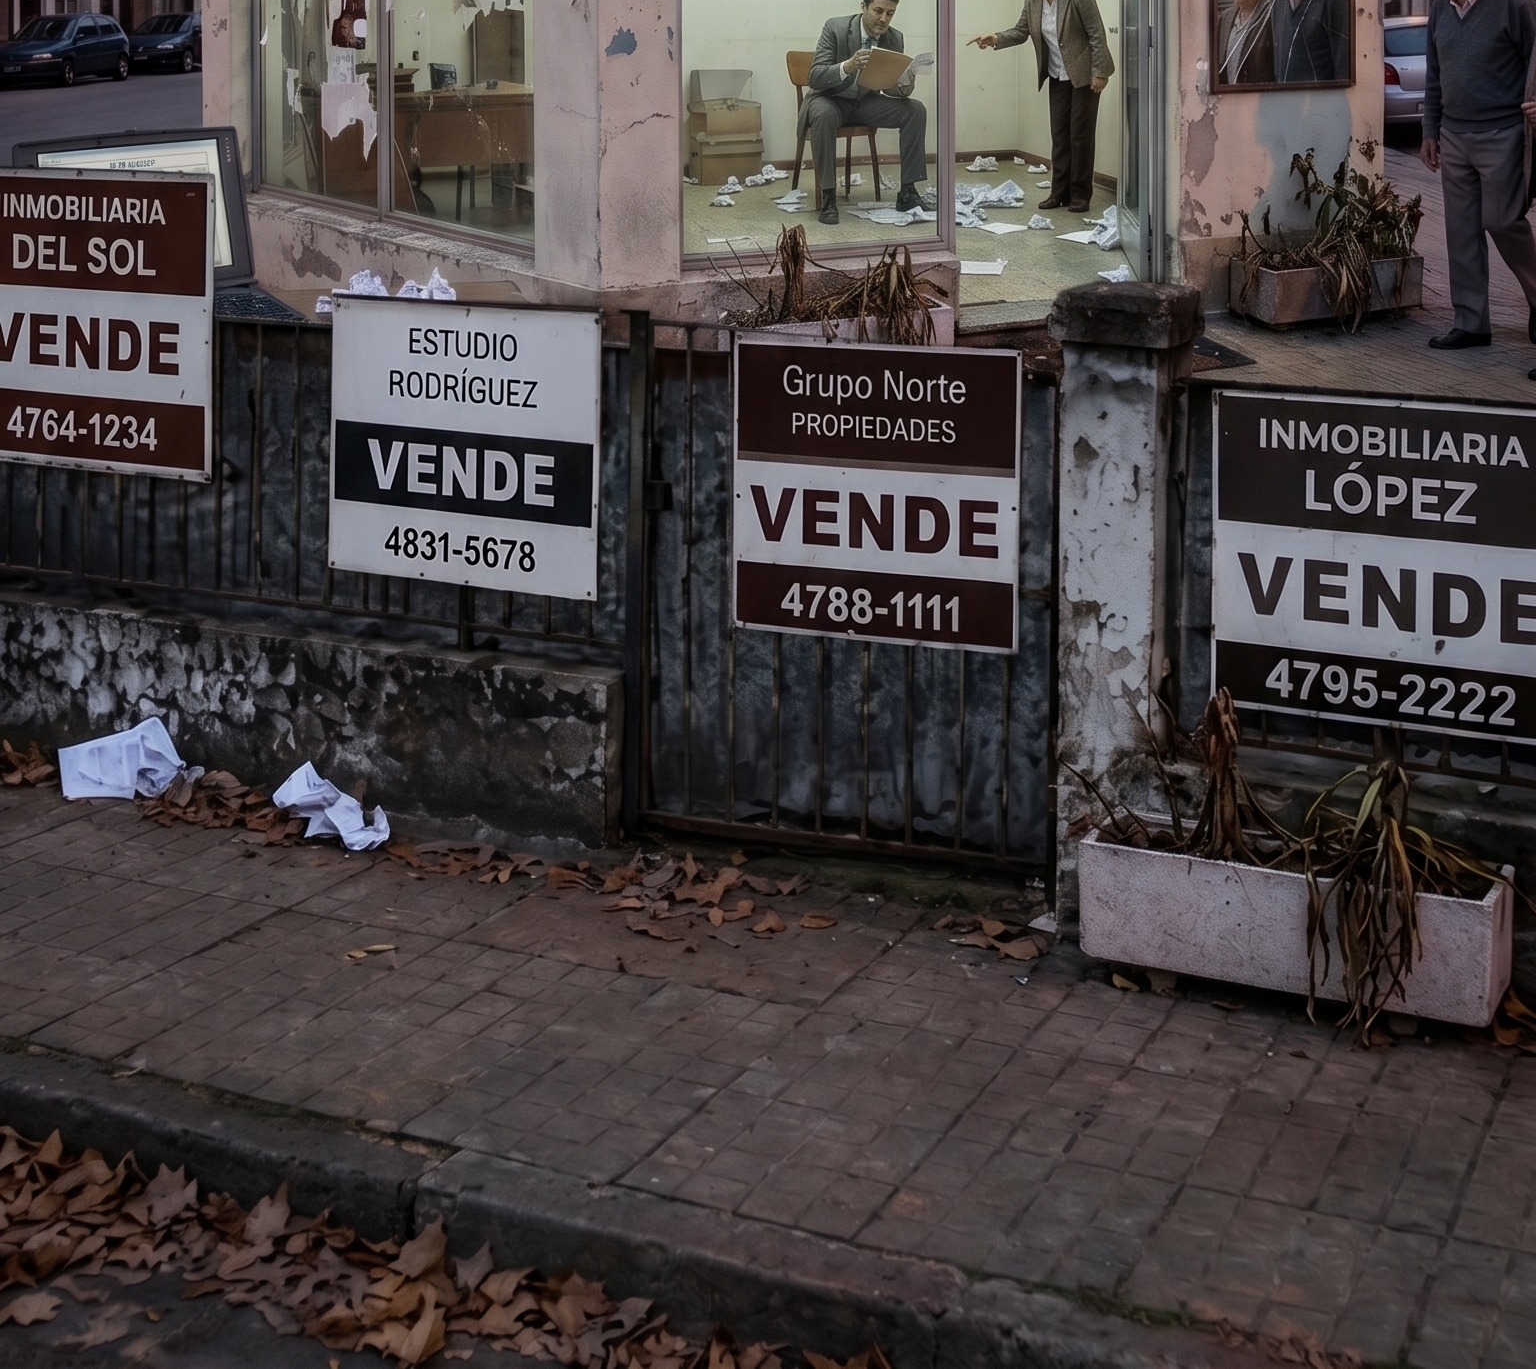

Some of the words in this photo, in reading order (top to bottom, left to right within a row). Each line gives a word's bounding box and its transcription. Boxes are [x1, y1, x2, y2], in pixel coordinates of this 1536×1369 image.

[3, 193, 167, 225] INMOBILIARIA
[12, 233, 78, 273] DEL
[87, 237, 157, 277] SOL
[0, 312, 180, 376] VENDE
[408, 328, 518, 362] ESTUDIO
[389, 368, 538, 408] RODRÍGUEZ
[783, 365, 873, 405] Grupo
[884, 370, 967, 404] Norte
[7, 405, 157, 451] 4764-1234
[792, 412, 956, 443] PROPIEDADES
[1259, 417, 1530, 468] INMOBILIARIA
[367, 438, 555, 507] VENDE
[1305, 461, 1478, 525] LÓPEZ
[750, 484, 999, 559] VENDE
[385, 526, 536, 572] 4831-5678
[781, 583, 959, 632] 4788-1111
[1237, 551, 1536, 646] VENDE
[1265, 658, 1517, 727] 4795-2222
